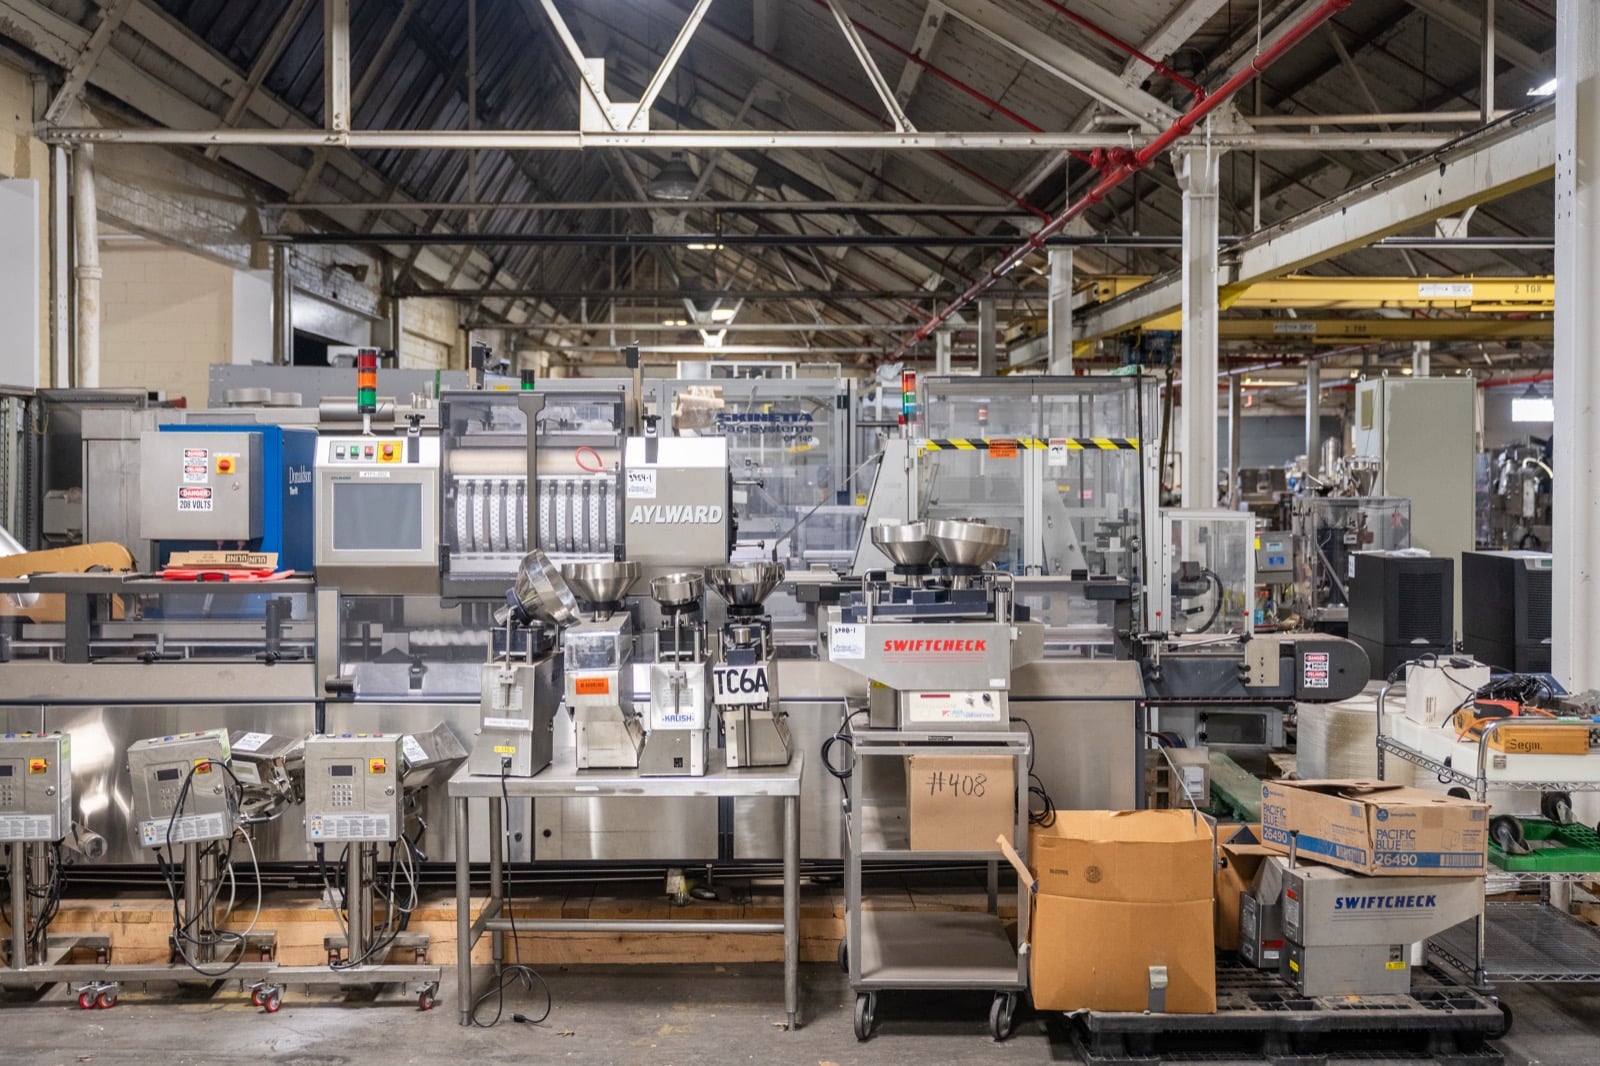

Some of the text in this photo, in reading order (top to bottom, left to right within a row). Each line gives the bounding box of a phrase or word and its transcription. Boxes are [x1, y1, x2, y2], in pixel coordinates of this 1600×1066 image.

[717, 424, 814, 434] Pac-Systeme
[289, 464, 312, 484] Donaldson
[179, 500, 212, 510] 208 VOLTS
[630, 504, 724, 525] AYLWARD
[249, 556, 266, 564] ULIN
[883, 639, 987, 652] SWIFTCHECK
[713, 668, 768, 695] TC6A
[926, 771, 988, 797] #408
[1263, 803, 1287, 818] PACIFIC
[1263, 812, 1279, 828] BLUE
[1263, 827, 1288, 844] 26490
[1376, 829, 1416, 840] PACIFIC
[1376, 840, 1400, 850] BLUE
[1375, 853, 1418, 866] 26490
[1334, 895, 1437, 910] SWIFTCHECK
